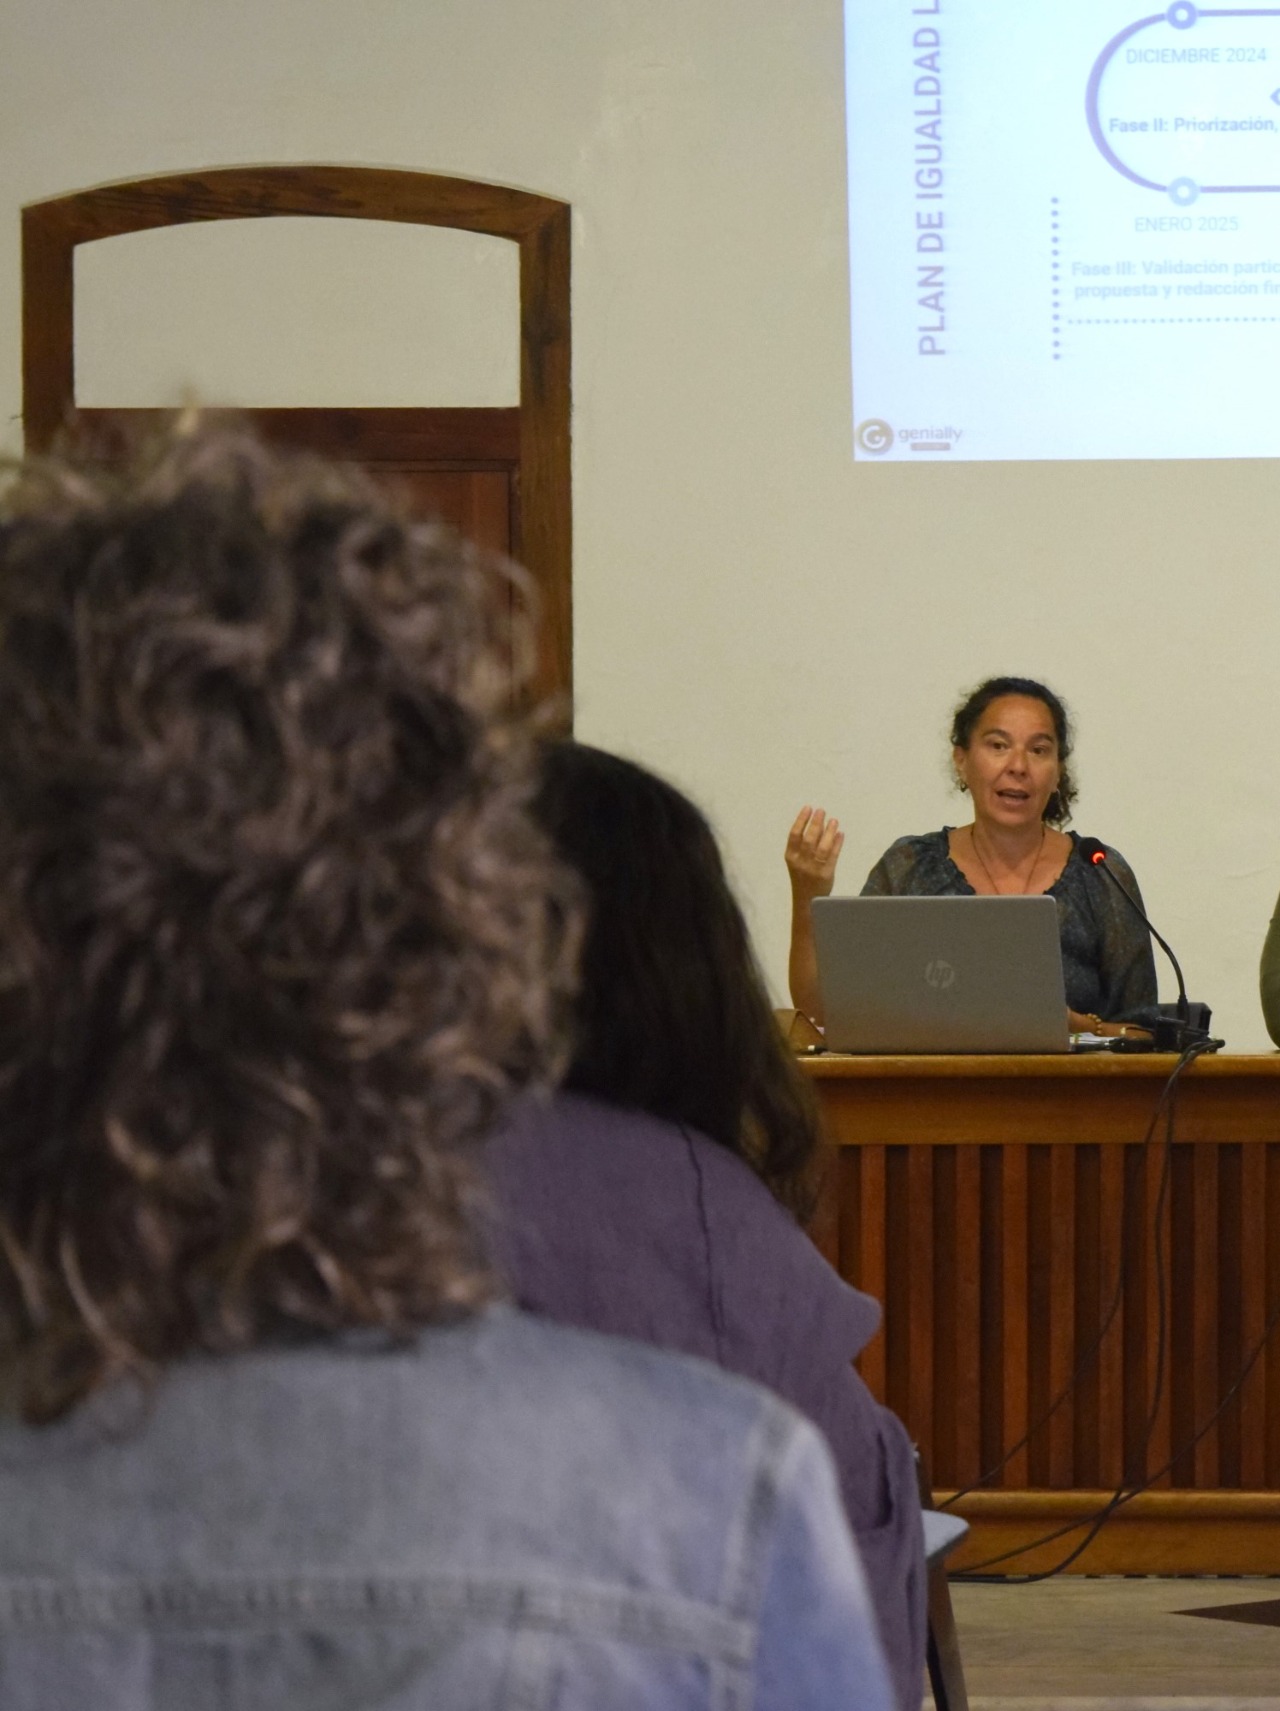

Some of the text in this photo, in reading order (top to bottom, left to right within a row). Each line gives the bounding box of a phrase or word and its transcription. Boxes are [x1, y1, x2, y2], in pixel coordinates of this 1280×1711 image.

[1125, 48, 1267, 65] DICIEMBRE 2024
[911, 26, 944, 200] IGUALDAD
[1109, 118, 1149, 133] Fase
[1153, 118, 1169, 132] II:
[1173, 116, 1279, 135] Priorización,
[915, 210, 945, 253] DE
[1134, 216, 1239, 232] ENERO 2025
[1072, 262, 1111, 276] Fase
[1116, 262, 1136, 275] III:
[1141, 259, 1229, 275] Validación
[1074, 283, 1158, 300] propuesta
[1162, 285, 1171, 298] y
[1176, 280, 1258, 296] redacción
[917, 264, 947, 356] PLAN
[898, 426, 963, 443] genially
[925, 960, 955, 989] hp
